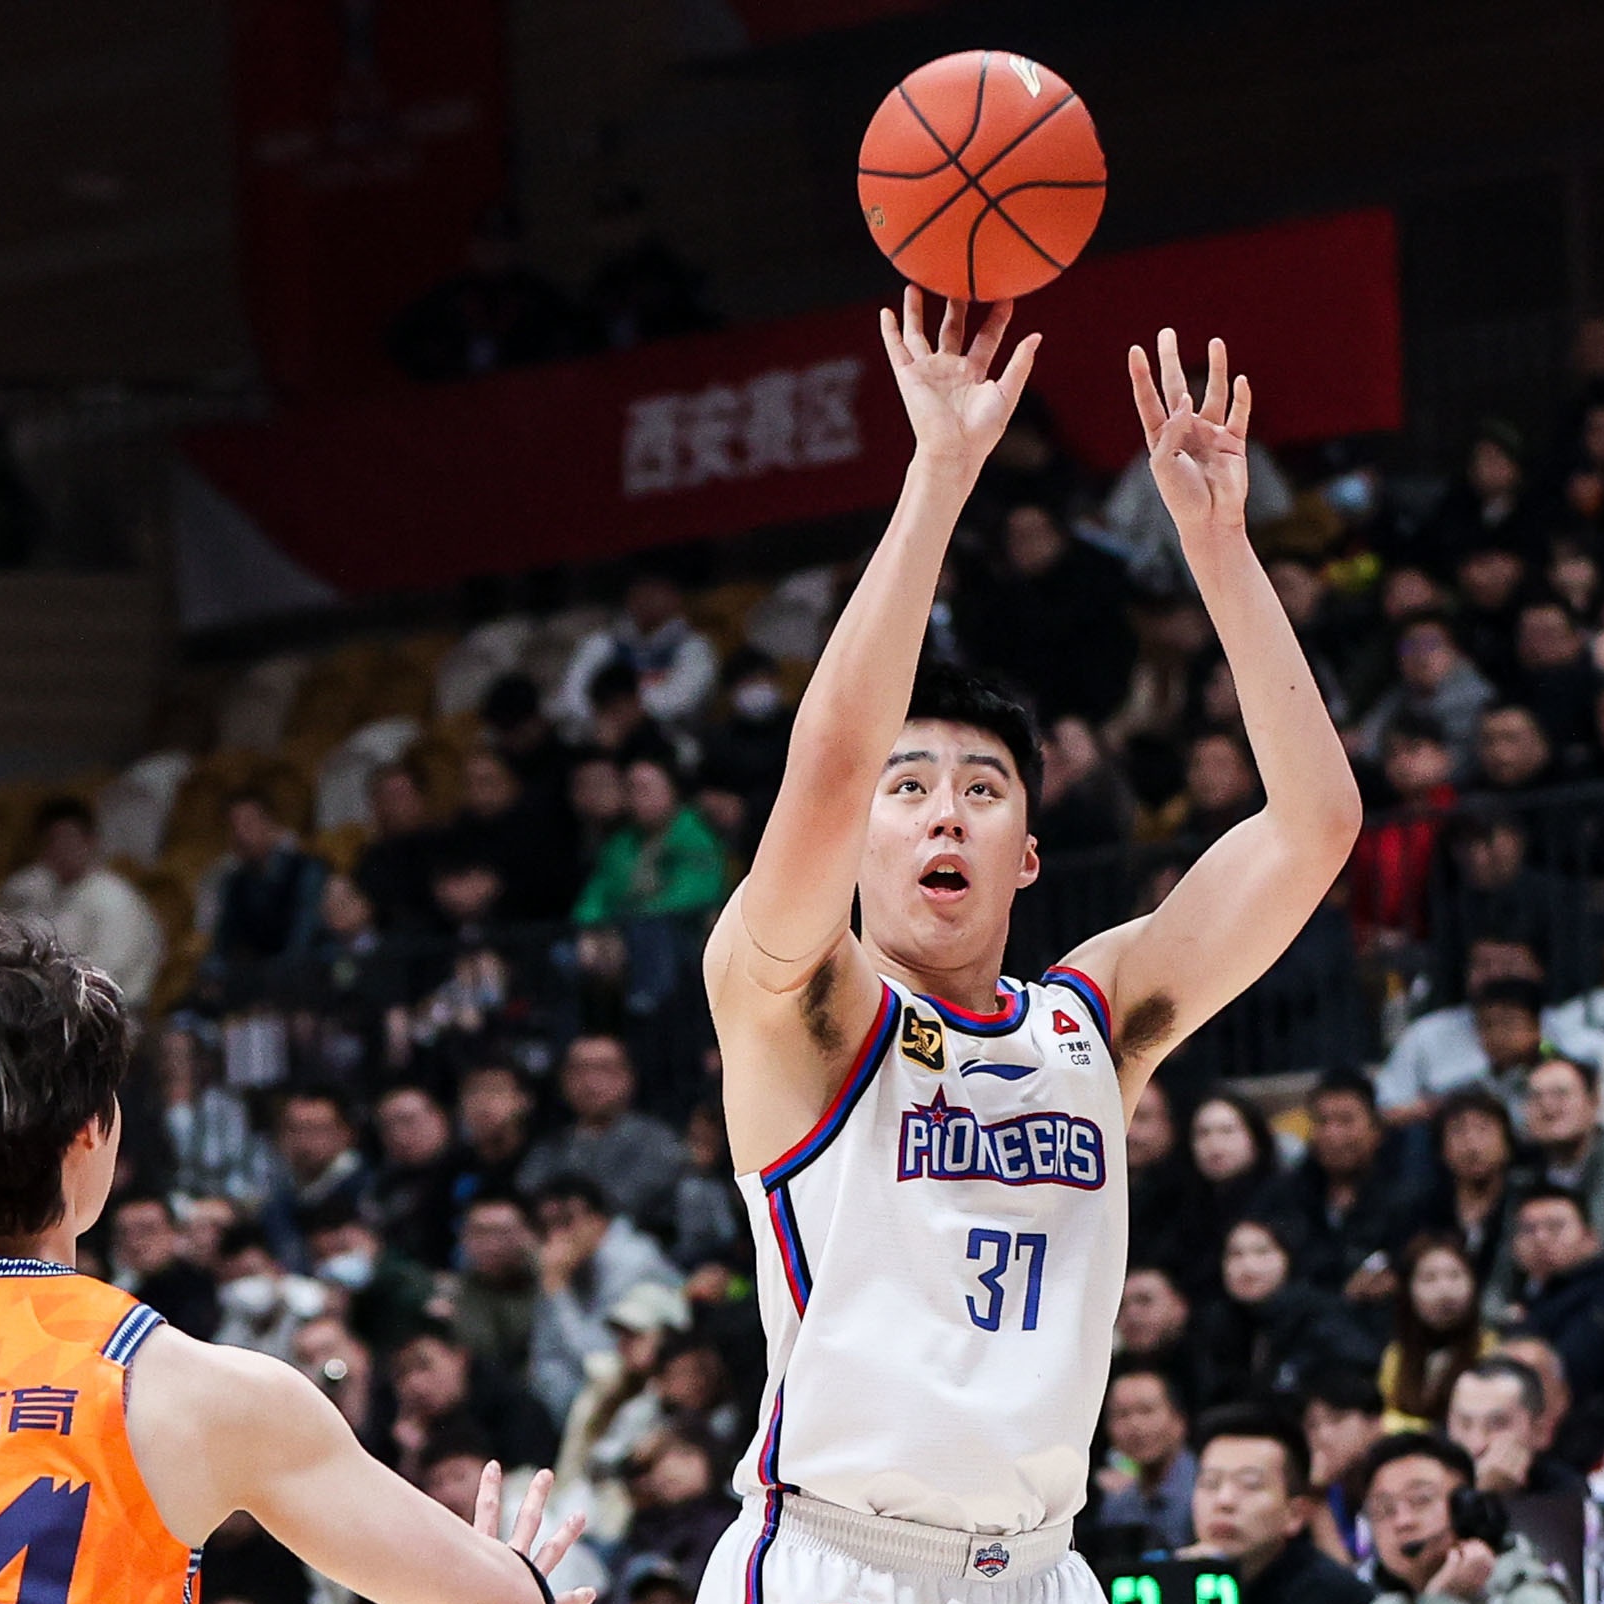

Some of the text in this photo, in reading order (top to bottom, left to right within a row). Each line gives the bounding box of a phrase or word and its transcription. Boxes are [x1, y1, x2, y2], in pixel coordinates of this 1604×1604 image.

[625, 360, 861, 496] 西安赛区
[1070, 1054, 1091, 1065] CGB
[901, 1112, 1103, 1186] PIONEERS
[965, 1227, 1047, 1333] 37
